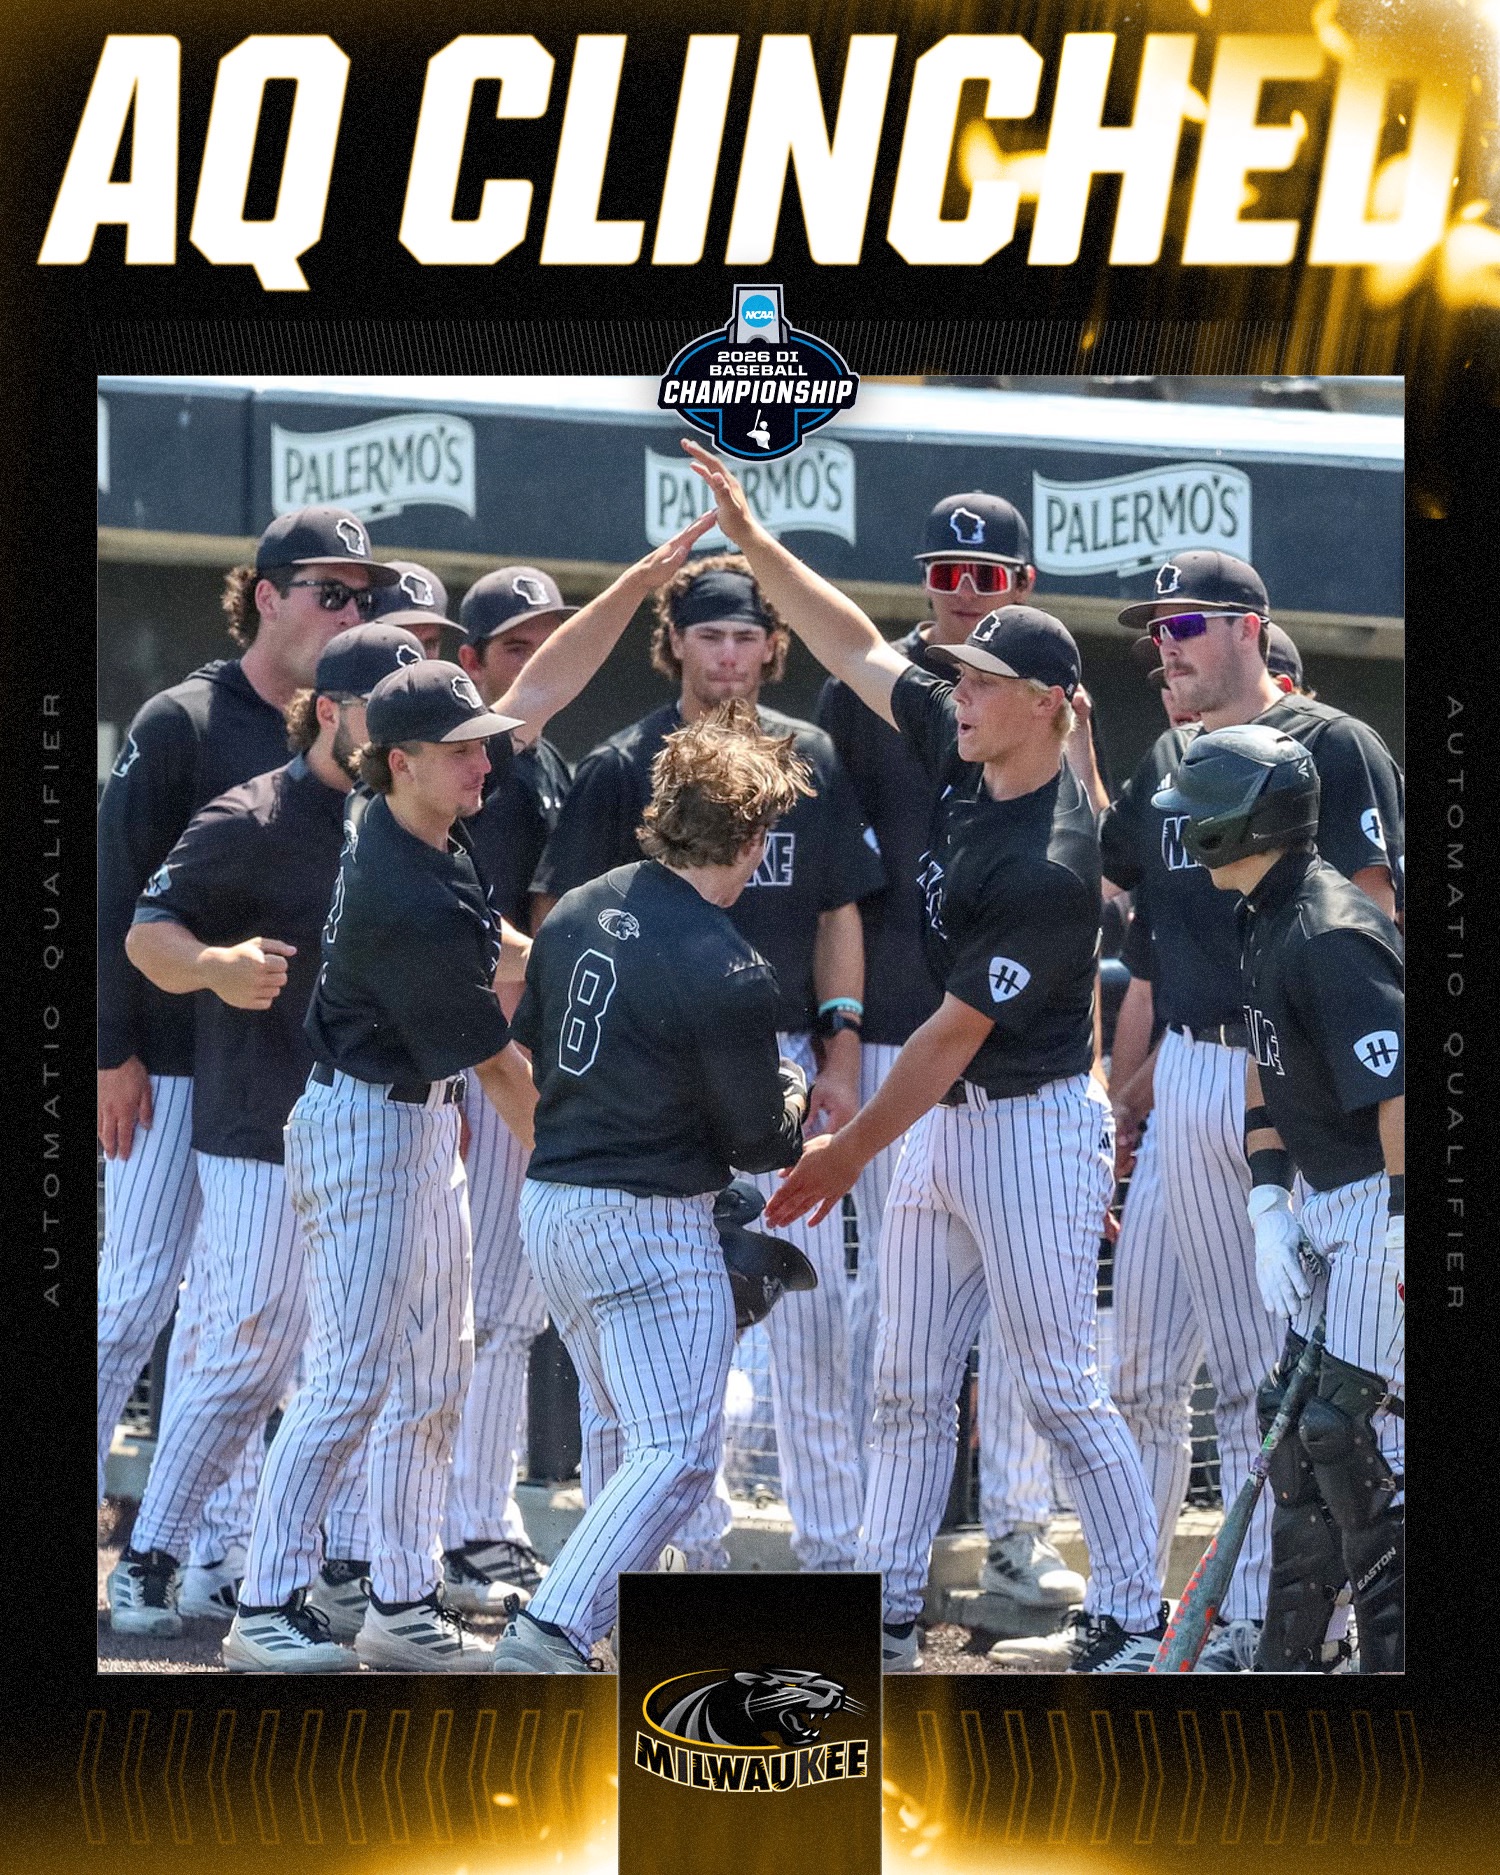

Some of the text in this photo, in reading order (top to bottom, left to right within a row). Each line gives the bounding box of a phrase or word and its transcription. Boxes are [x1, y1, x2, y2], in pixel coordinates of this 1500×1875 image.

[286, 425, 464, 503] PALERMO'S
[1046, 474, 1239, 554] PALERMO'S
[558, 948, 617, 1076] 8
[1356, 1546, 1397, 1591] EASTON
